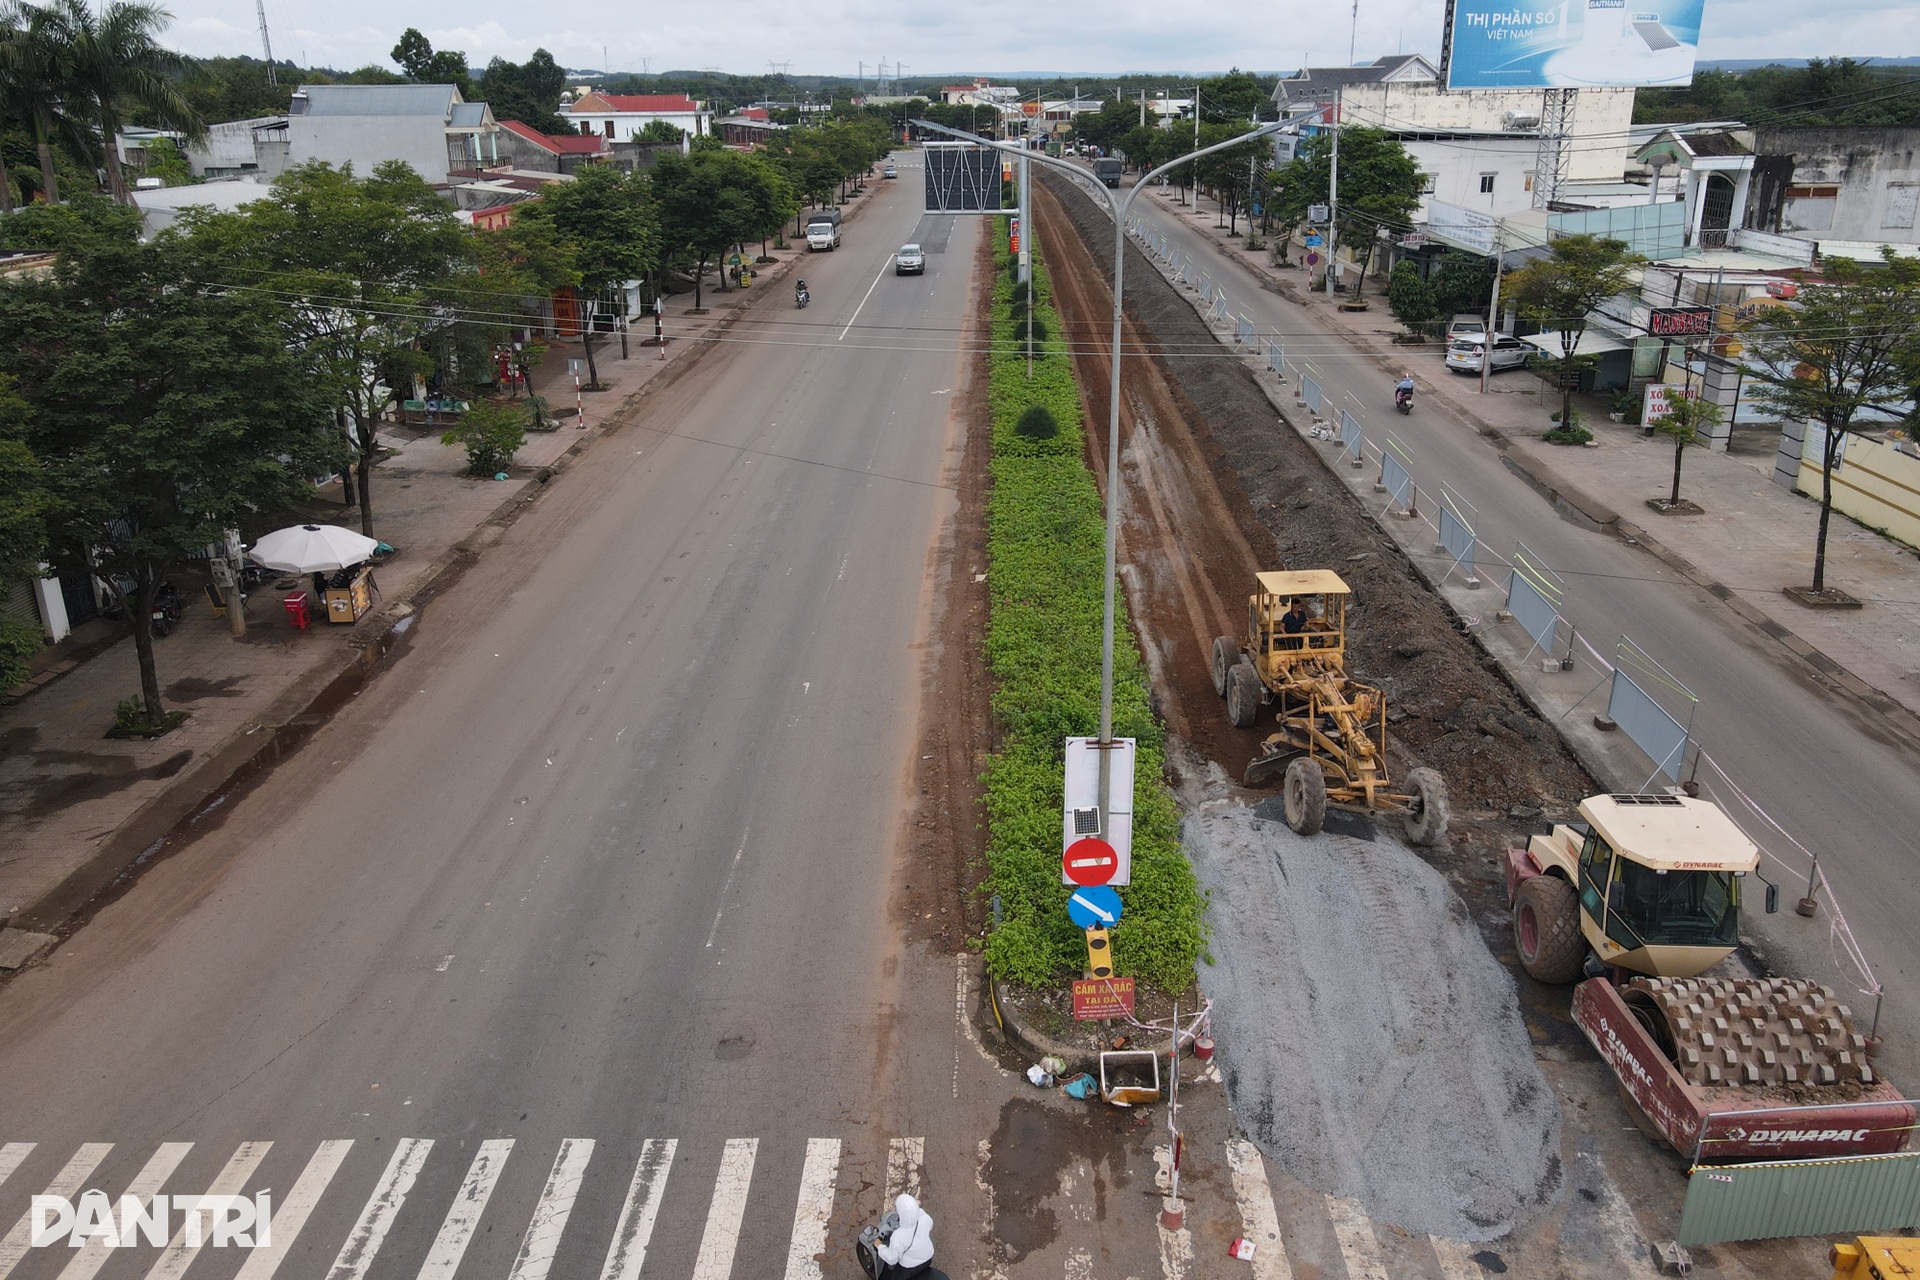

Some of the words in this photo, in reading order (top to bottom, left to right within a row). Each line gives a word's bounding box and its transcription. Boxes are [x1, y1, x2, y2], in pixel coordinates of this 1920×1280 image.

[1466, 13, 1489, 28] THỊ
[1492, 8, 1532, 26] PHẦN
[1535, 7, 1555, 24] SỐ
[1487, 28, 1508, 40] VIỆT
[1510, 29, 1533, 39] NAM
[1653, 311, 1710, 334] MASSAGE
[1075, 982, 1096, 995] CẤM
[1113, 981, 1132, 992] RÁC
[1085, 997, 1100, 1006] TẠI
[1748, 1129, 1870, 1142] DYNAPAC
